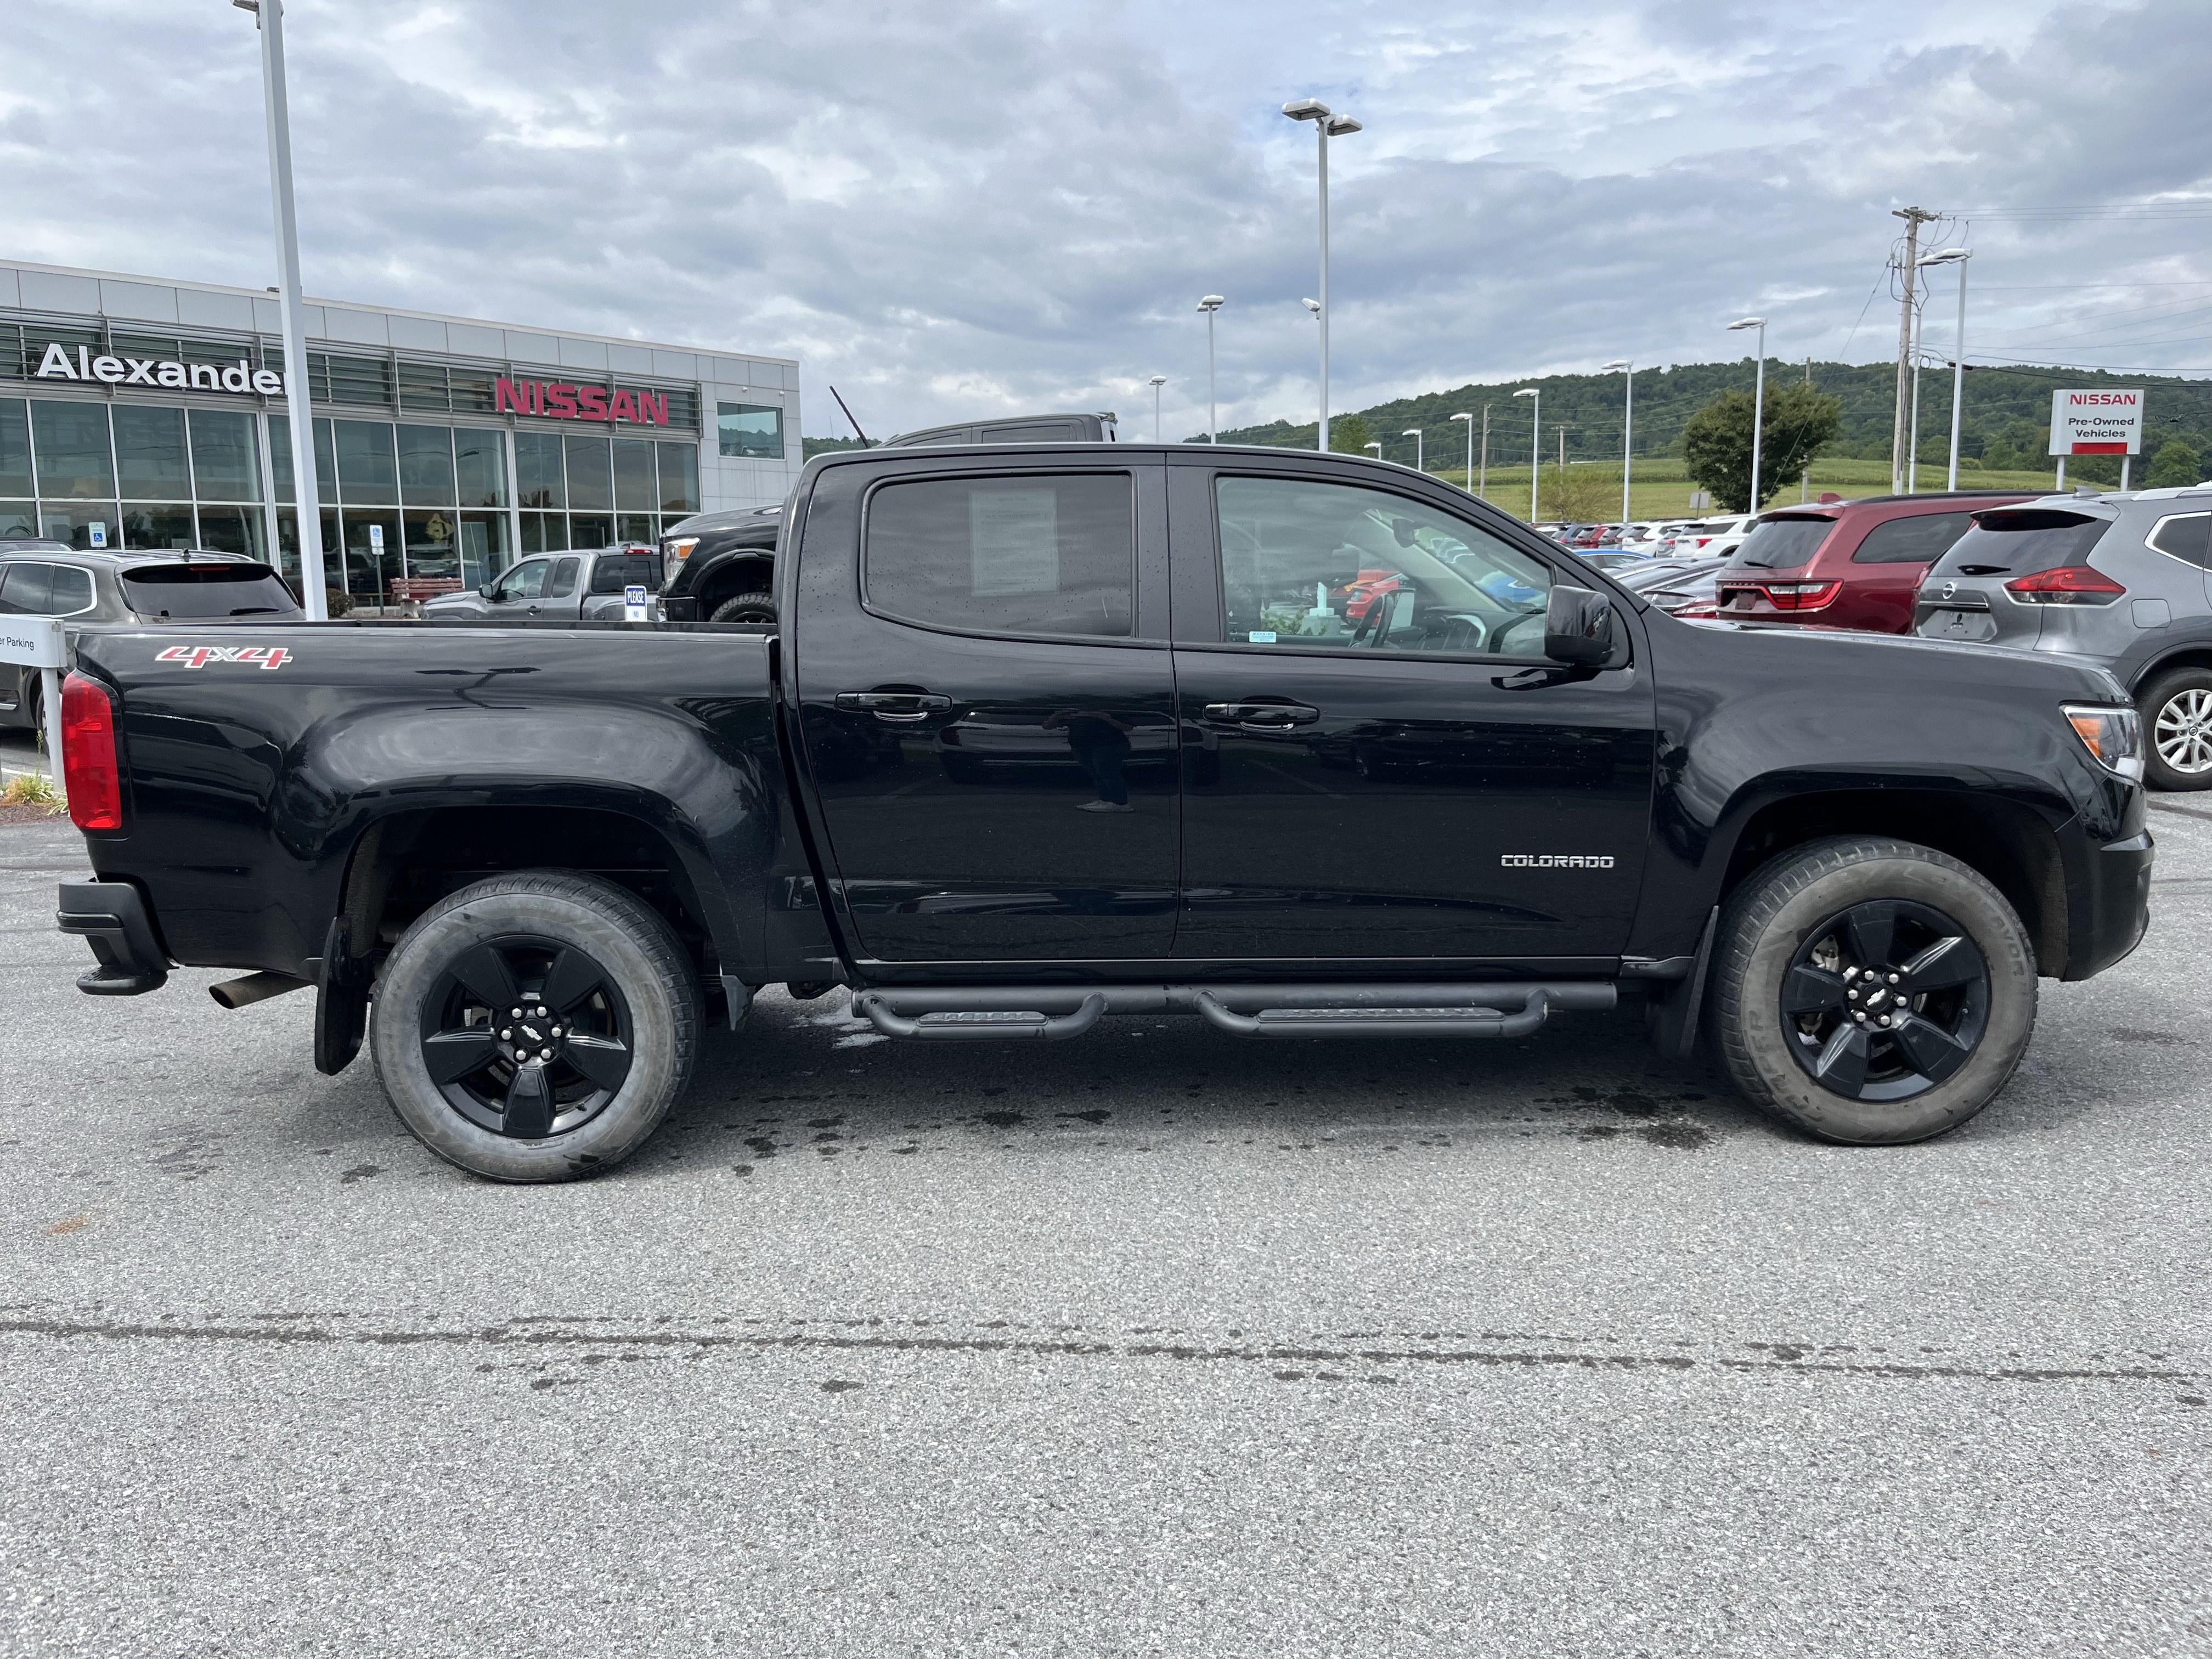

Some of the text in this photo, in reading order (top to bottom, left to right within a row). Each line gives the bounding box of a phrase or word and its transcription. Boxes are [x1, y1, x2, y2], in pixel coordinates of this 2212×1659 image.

[494, 376, 668, 425] NISSAN
[2070, 394, 2136, 405] NISSAN
[2068, 417, 2135, 426] Pre-Owned
[627, 591, 645, 604] PLEASE
[7, 636, 35, 651] Parking
[1500, 855, 1615, 868] COLORADO
